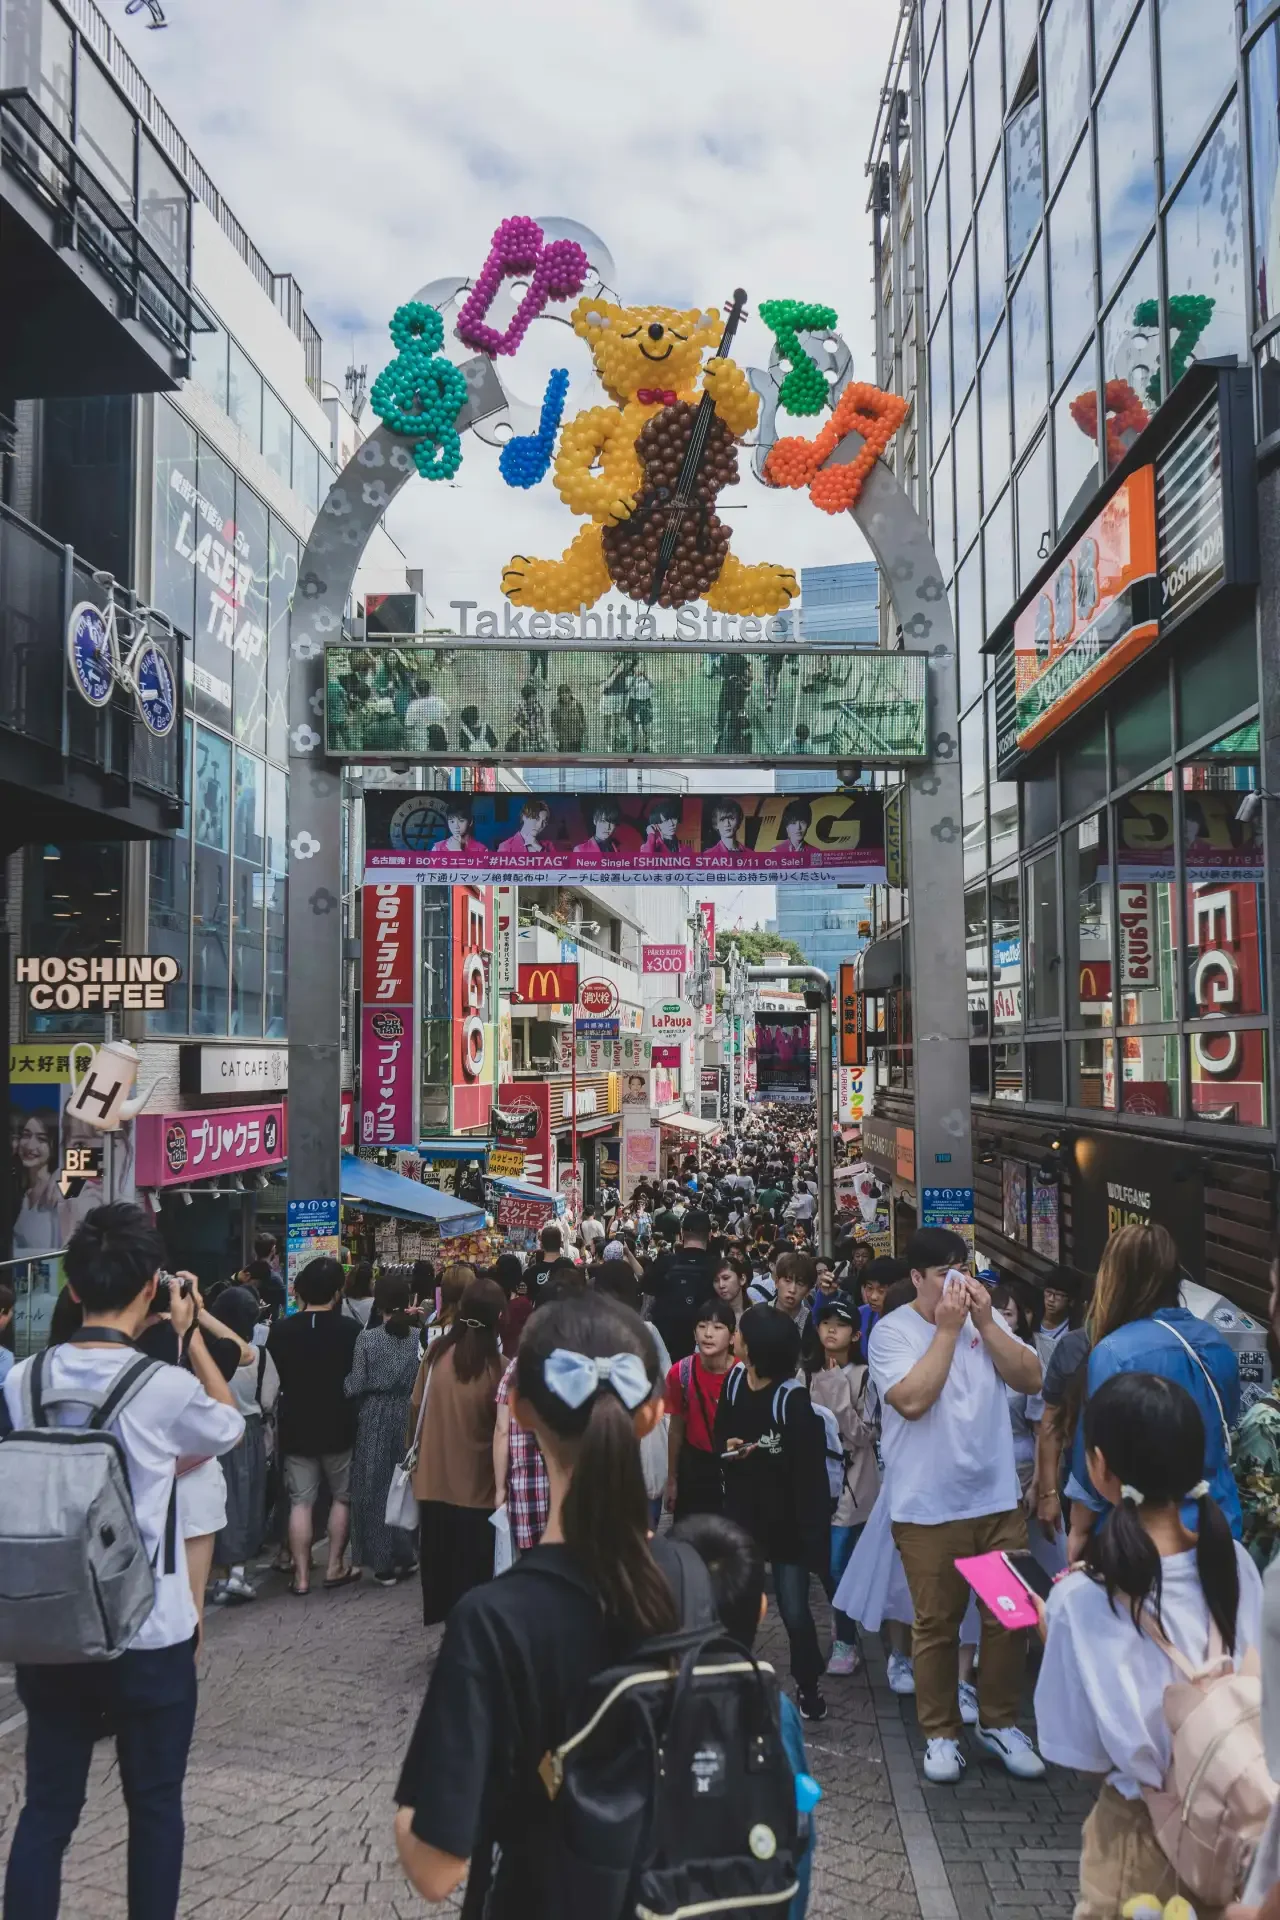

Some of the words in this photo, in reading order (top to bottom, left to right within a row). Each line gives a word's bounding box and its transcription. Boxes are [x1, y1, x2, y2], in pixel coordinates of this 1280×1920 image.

[174, 510, 251, 607] LASER
[1162, 525, 1224, 605] YOSHINOYA
[206, 590, 266, 664] TRAP
[450, 600, 658, 641] Takeshita
[675, 604, 807, 643] Street
[576, 858, 597, 867] New
[600, 858, 630, 868] Single
[736, 858, 759, 867] 9/11
[764, 858, 778, 867] On
[781, 858, 804, 867] Sale!
[16, 956, 178, 983] HOSHINO
[646, 957, 682, 971] ¥300
[30, 983, 165, 1010] COFFEE
[584, 991, 610, 1004] 消火栓
[652, 1014, 662, 1028] La
[664, 1014, 692, 1028] Pausa
[221, 1061, 241, 1076] CAT
[244, 1061, 268, 1076] CAFE
[75, 1071, 122, 1119] H
[840, 1068, 848, 1107] PURIKURA
[849, 1066, 866, 1120] プリクラ
[66, 1149, 92, 1170] BF
[488, 1163, 509, 1174] HAPPY
[509, 1167, 522, 1177] ONE
[1107, 1181, 1151, 1210] WOLFGANG
